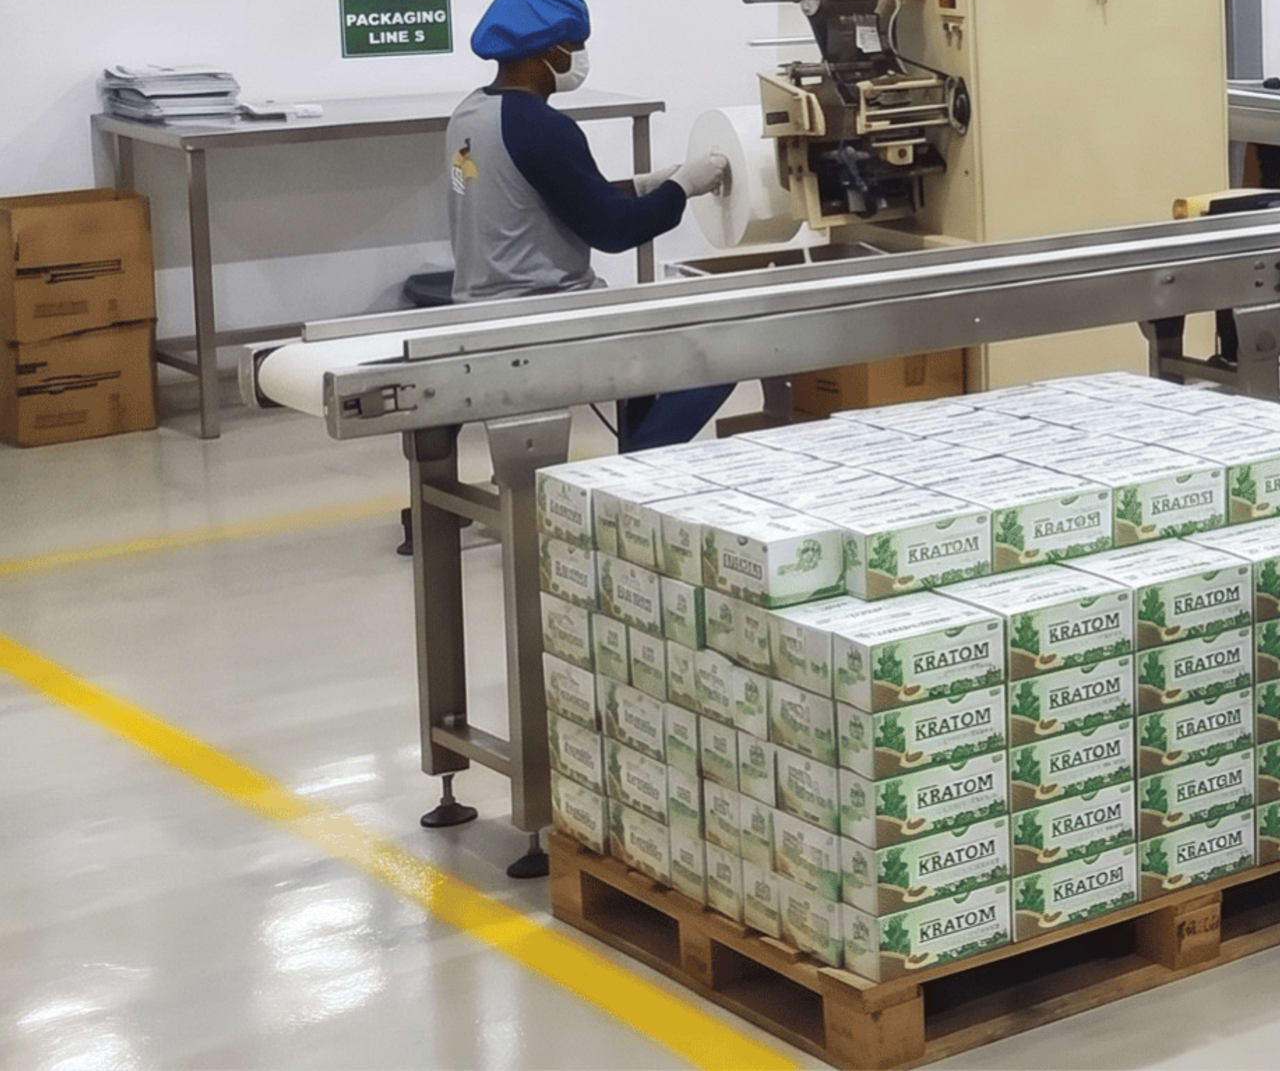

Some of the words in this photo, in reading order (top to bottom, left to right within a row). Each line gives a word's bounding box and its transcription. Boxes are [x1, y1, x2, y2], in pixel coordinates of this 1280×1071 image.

[346, 10, 446, 26] PACKAGING
[368, 30, 409, 44] LINE
[908, 536, 979, 563] KRATOM
[1049, 612, 1120, 643] KRATOM
[914, 641, 989, 674] KRATOM
[1049, 677, 1120, 709] KRATOM
[915, 707, 990, 741] KRATOM
[1176, 708, 1241, 740] KRATOM
[1049, 740, 1120, 773] KRATOM
[917, 774, 993, 809] KRATOM
[1051, 804, 1121, 838] KRATOM
[918, 840, 995, 876] KRATOM
[919, 906, 996, 942] KRATOM
